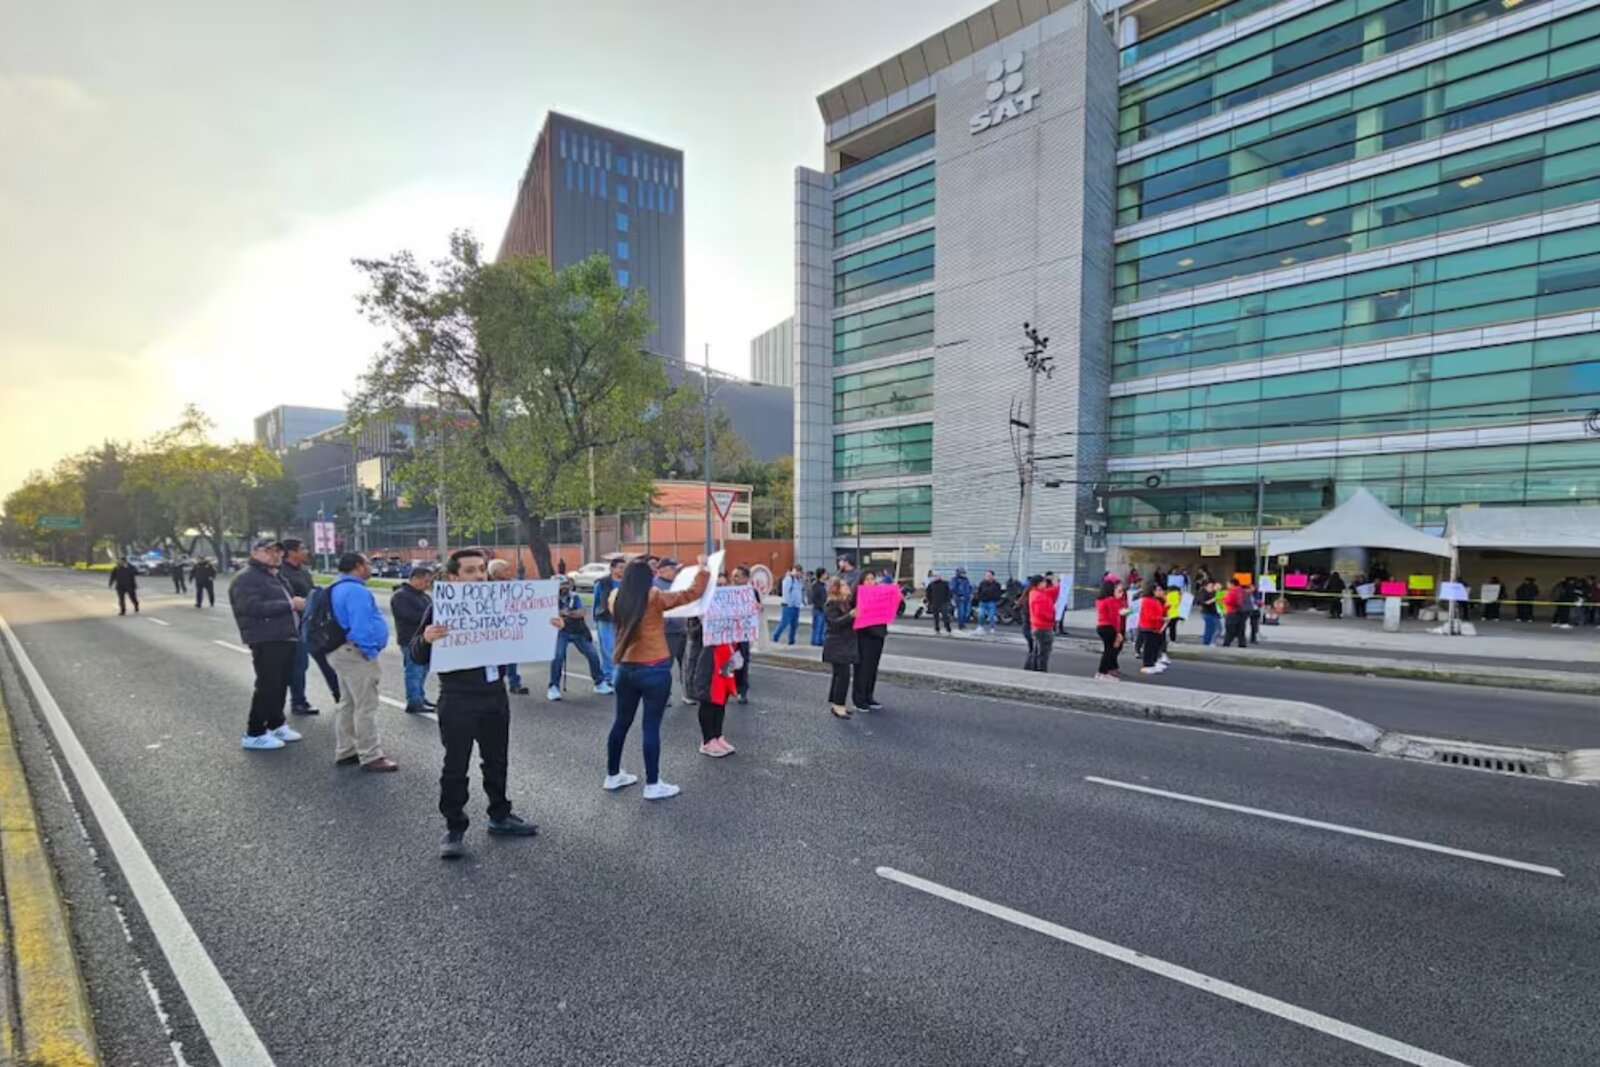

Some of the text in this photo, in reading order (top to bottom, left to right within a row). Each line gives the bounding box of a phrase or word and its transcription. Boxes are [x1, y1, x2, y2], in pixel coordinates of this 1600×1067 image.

[970, 87, 1041, 135] SAT
[1044, 541, 1068, 552] 507
[436, 583, 535, 600] NO PODEMOS
[436, 602, 472, 616] VIVIR
[476, 600, 501, 615] DEL
